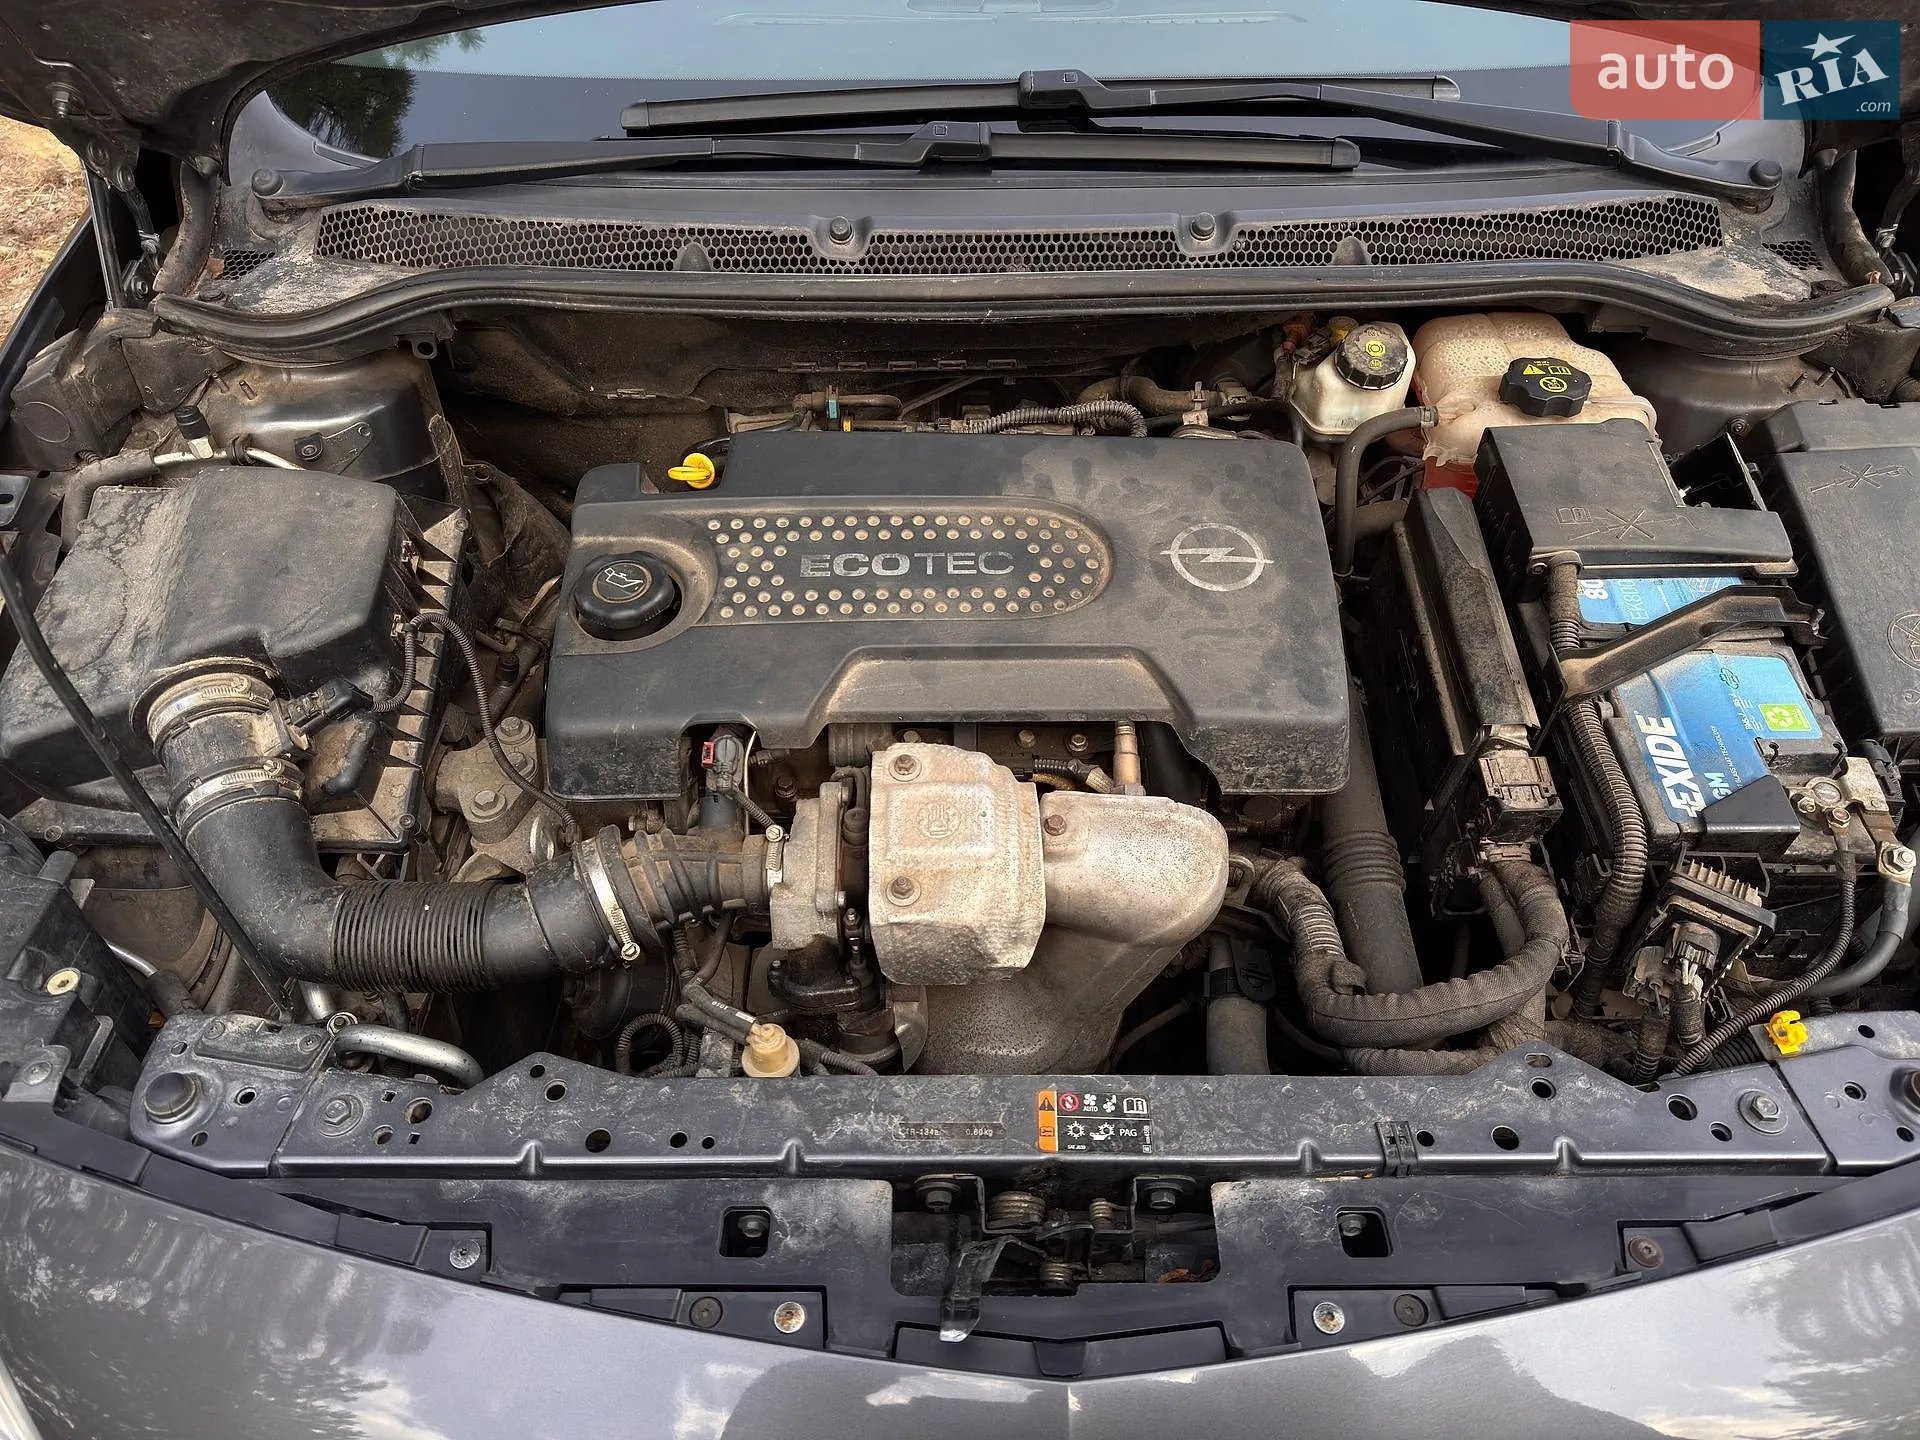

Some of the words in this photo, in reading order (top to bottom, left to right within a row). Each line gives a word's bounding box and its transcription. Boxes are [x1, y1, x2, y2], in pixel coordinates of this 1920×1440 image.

[799, 550, 1015, 578] ECOTEC
[1637, 714, 1705, 818] EXIDE
[1703, 772, 1733, 800] GM
[1119, 1129, 1137, 1137] PAG
